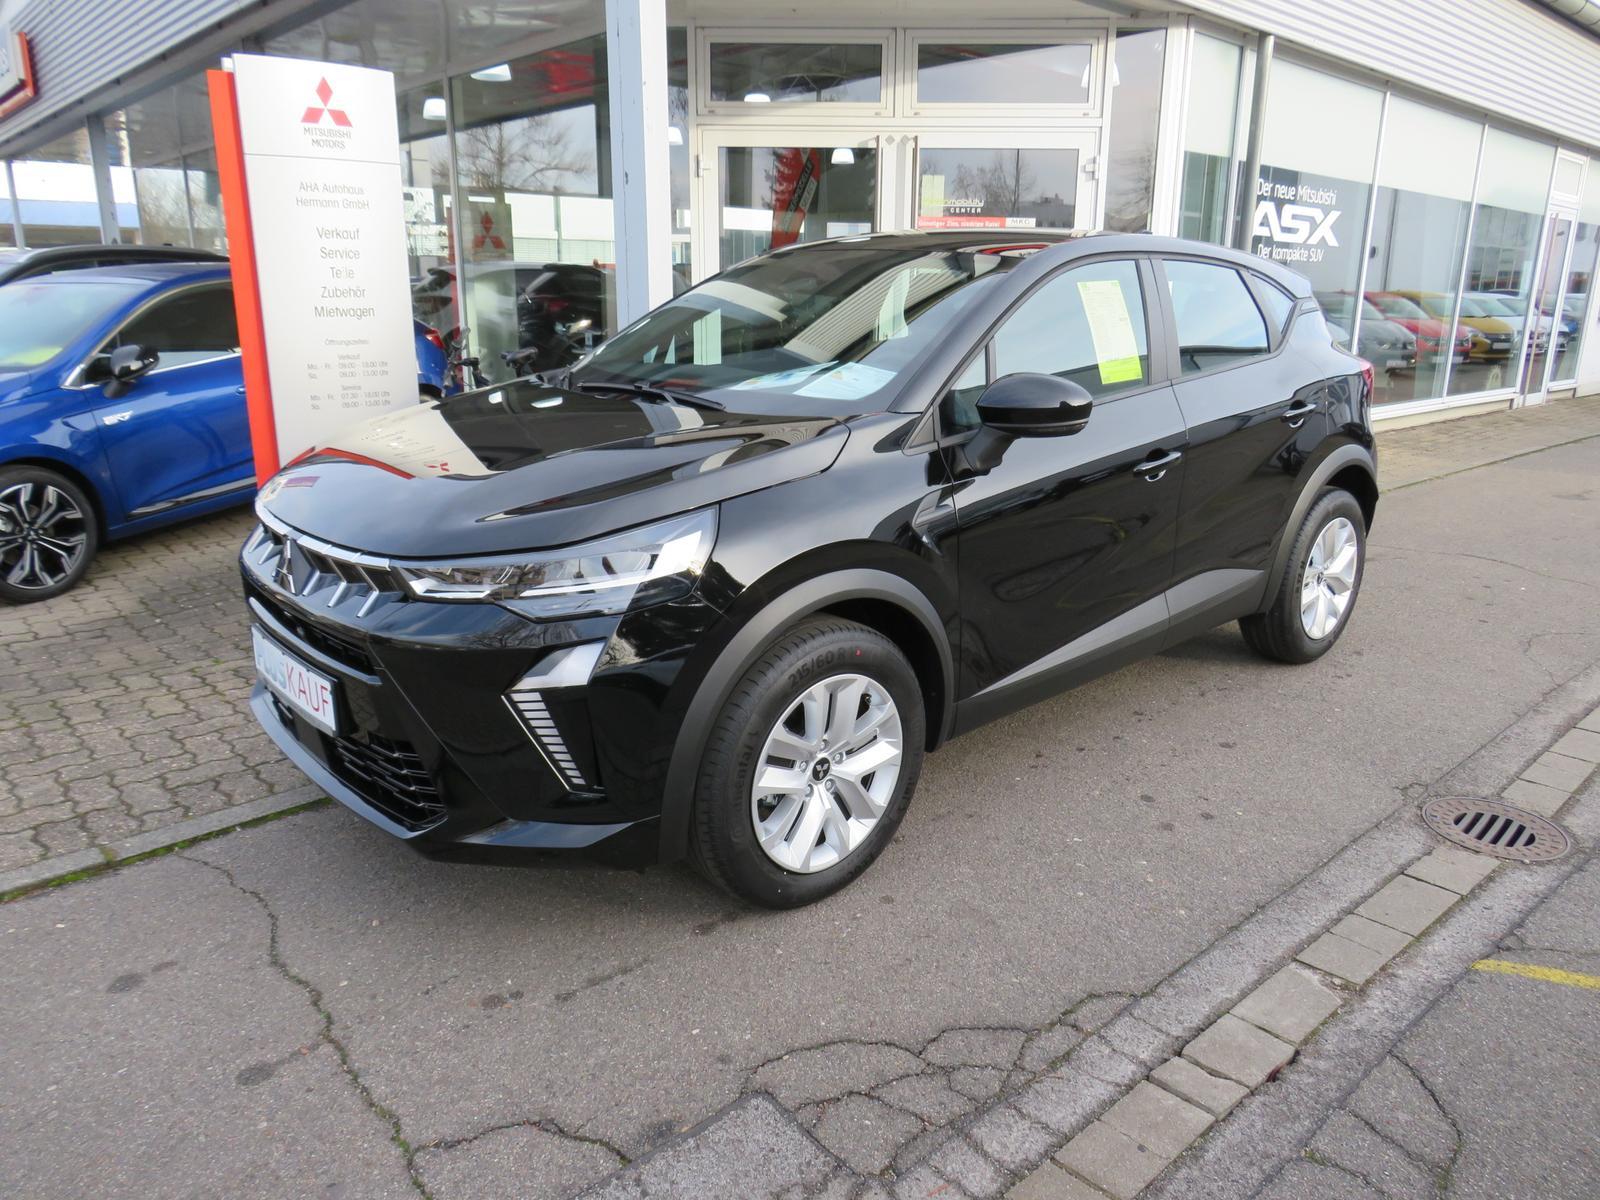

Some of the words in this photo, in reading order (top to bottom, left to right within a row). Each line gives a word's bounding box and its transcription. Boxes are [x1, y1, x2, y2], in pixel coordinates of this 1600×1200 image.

[303, 127, 351, 139] MITSUBISHI
[311, 138, 346, 150] MOTORS
[298, 181, 320, 193] AHA
[321, 182, 365, 195] Autohaus
[1256, 178, 1273, 196] Der
[1274, 184, 1296, 200] neue
[1296, 185, 1338, 206] Mitsubishi
[296, 197, 341, 208] Hermann
[342, 197, 370, 209] GmbH
[1252, 200, 1342, 248] ASX
[316, 227, 360, 240] Verkauf
[320, 246, 360, 260] Service
[1256, 244, 1273, 259] Der
[1272, 245, 1309, 264] kompakte
[1309, 247, 1325, 262] SUV
[330, 267, 355, 279] Teile
[320, 286, 367, 299] Zubehör
[314, 306, 375, 320] Mietwagen
